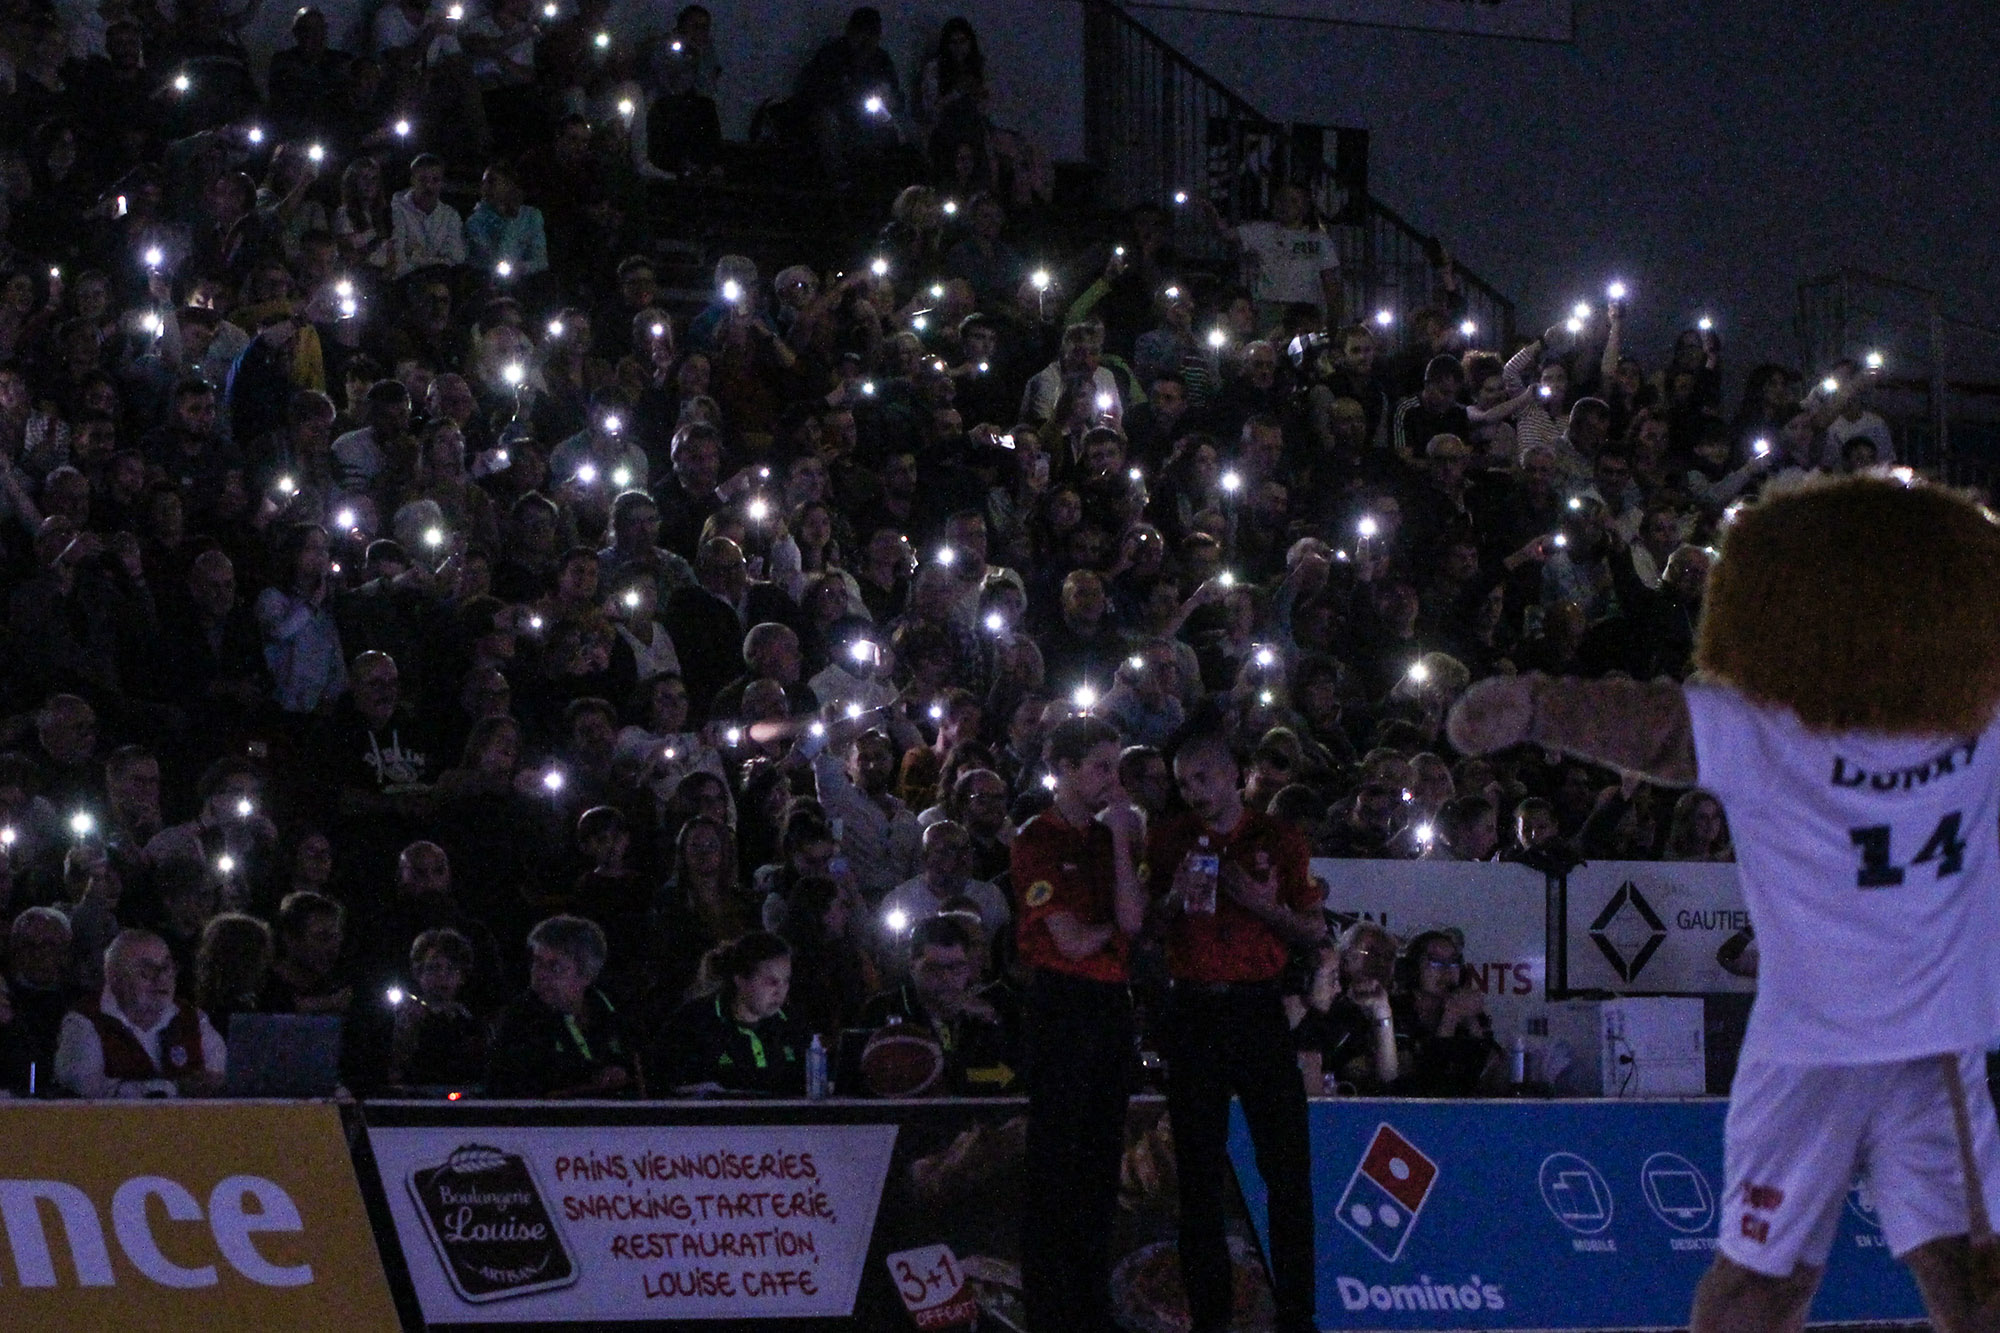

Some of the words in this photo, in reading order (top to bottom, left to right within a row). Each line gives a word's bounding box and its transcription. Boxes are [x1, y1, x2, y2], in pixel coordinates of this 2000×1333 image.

[1850, 810, 1967, 888] 14
[1462, 962, 1533, 995] NTS
[0, 1174, 315, 1289] nce
[444, 1206, 549, 1243] Louise
[896, 1255, 959, 1303] 3+1
[1336, 1274, 1505, 1311] Domino's
